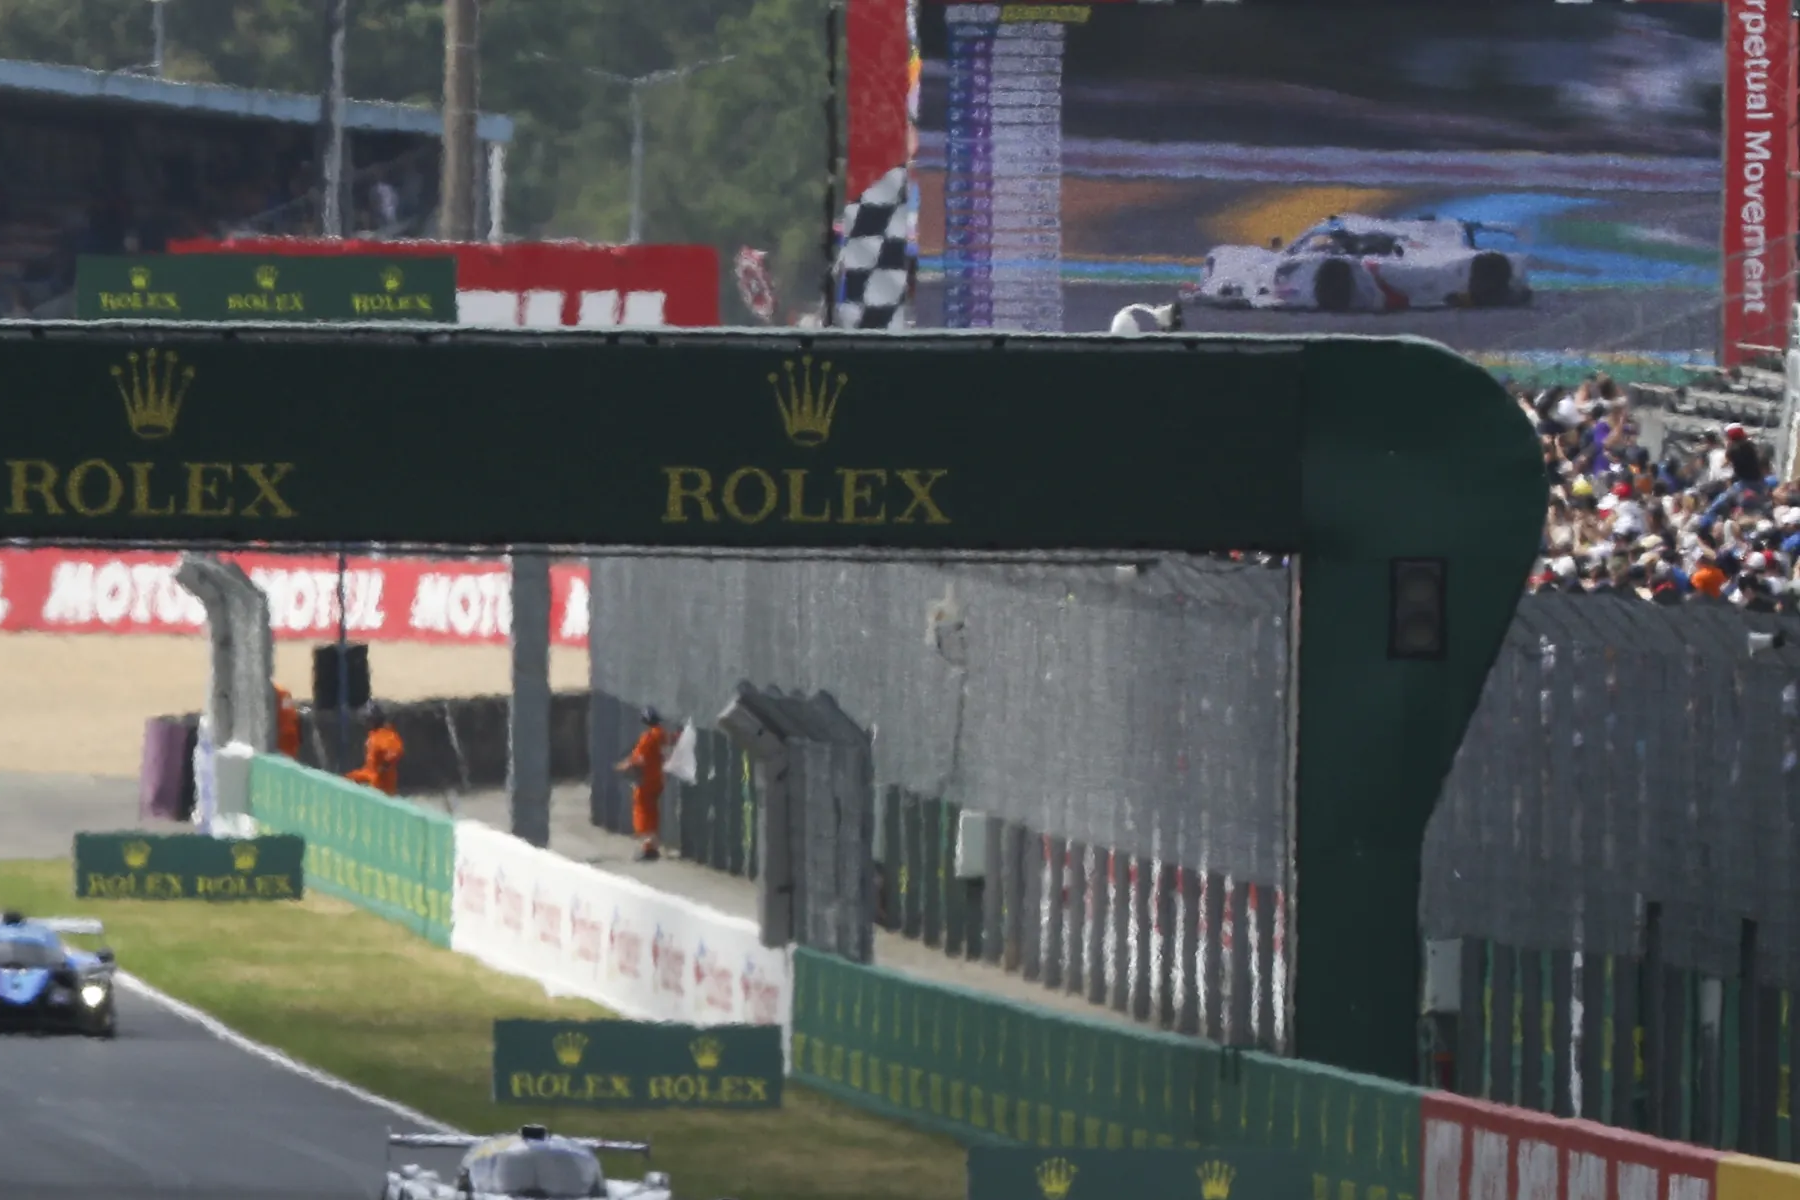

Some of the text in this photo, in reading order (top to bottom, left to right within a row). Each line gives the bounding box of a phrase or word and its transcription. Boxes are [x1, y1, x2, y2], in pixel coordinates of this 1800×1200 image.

[1740, 131, 1771, 313] Movement
[5, 458, 298, 518] ROLEX
[661, 465, 953, 525] ROLEX
[510, 1071, 768, 1101] ROLEX ROLEX
